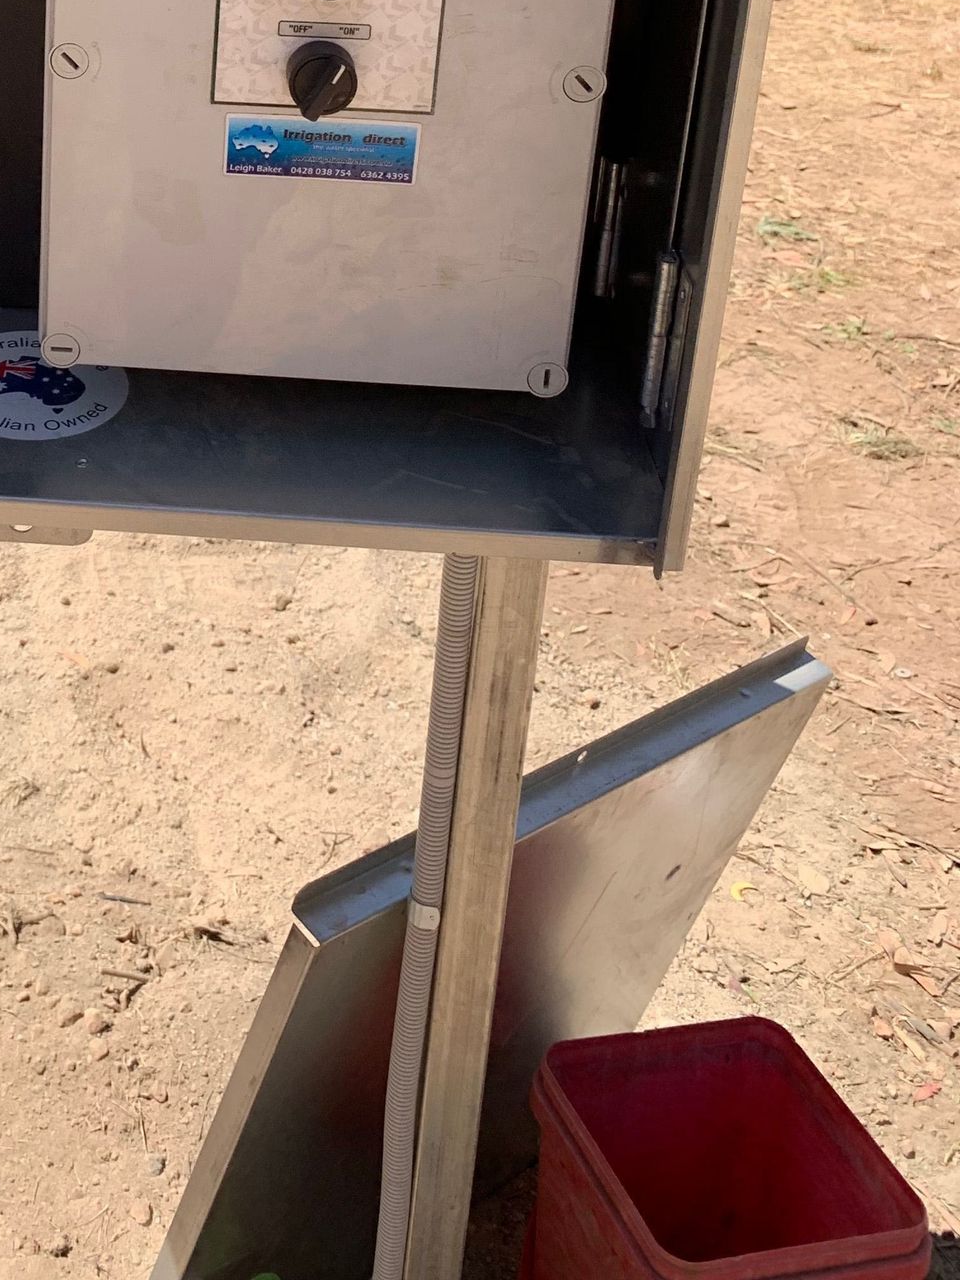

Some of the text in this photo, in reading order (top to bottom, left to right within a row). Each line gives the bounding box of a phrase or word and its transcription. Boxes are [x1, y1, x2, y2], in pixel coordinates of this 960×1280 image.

[289, 24, 313, 33] "OFF"
[339, 27, 360, 35] "ON"
[282, 128, 407, 147] Irrigation direct
[230, 164, 410, 181] Leigh Baker 0428 038 754 6362 4395
[44, 402, 109, 431] Owned
